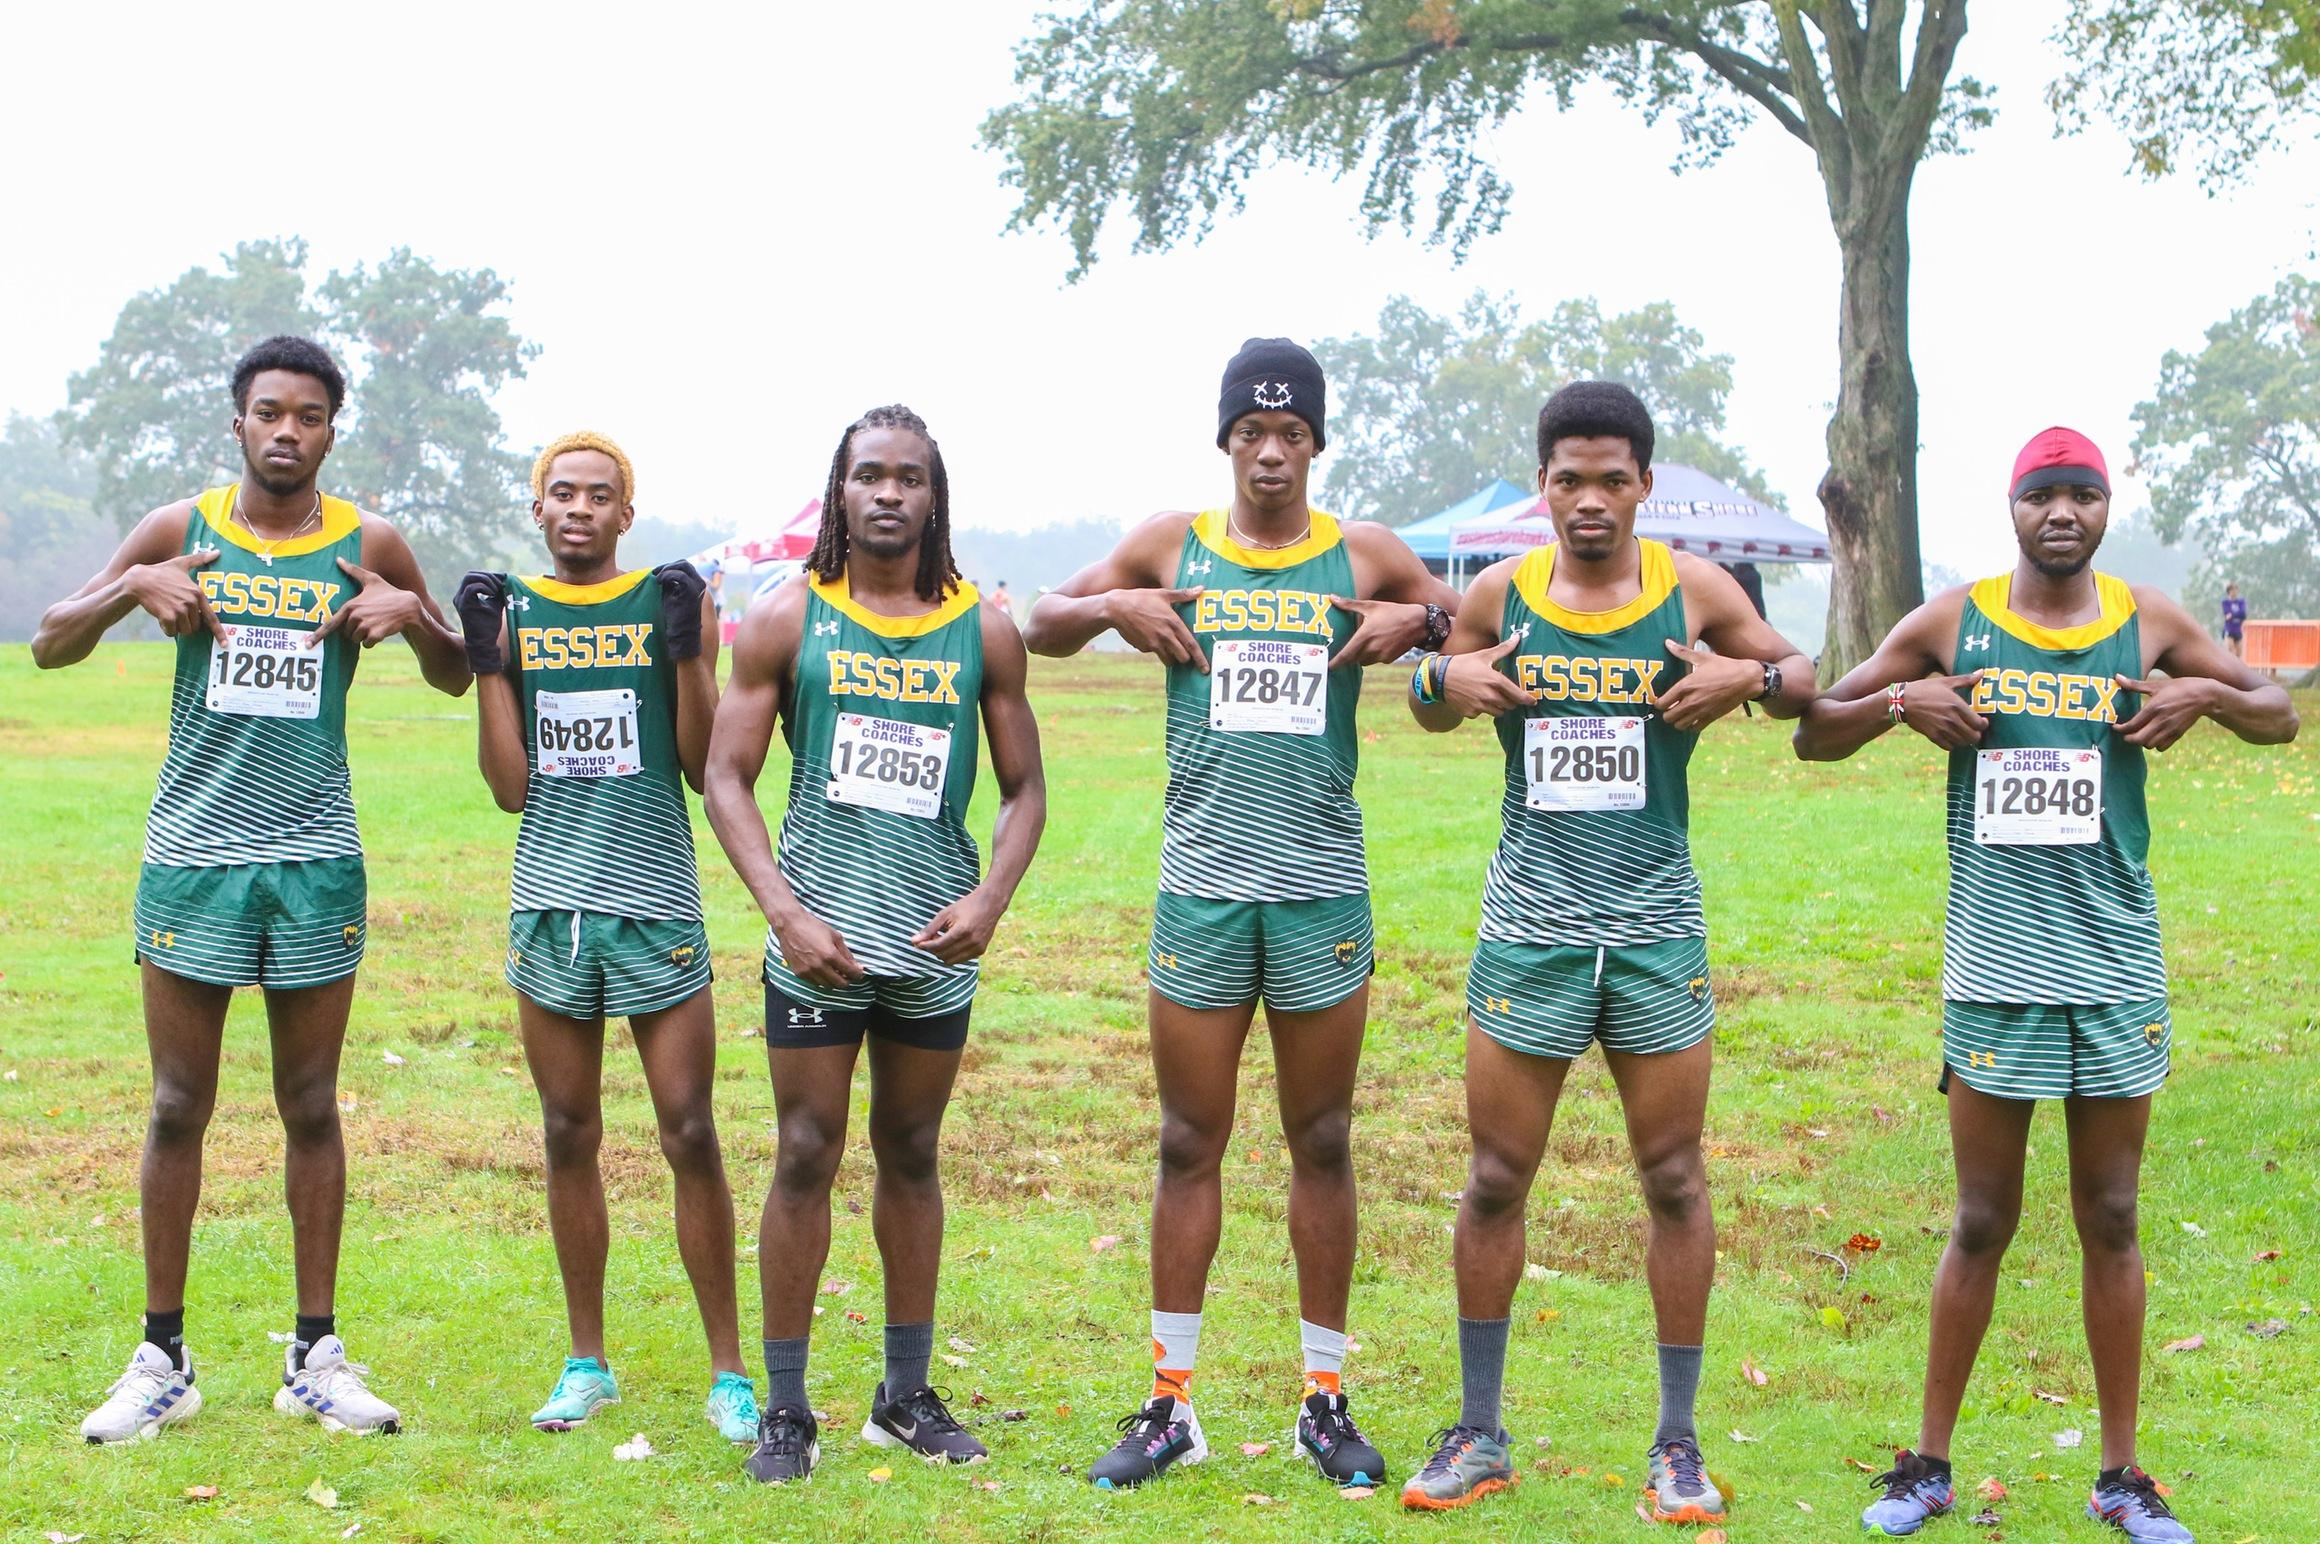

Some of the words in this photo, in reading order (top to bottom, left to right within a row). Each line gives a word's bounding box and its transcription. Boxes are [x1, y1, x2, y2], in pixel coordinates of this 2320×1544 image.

[196, 571, 341, 624] ESSEX
[1193, 589, 1334, 638] ESSEX
[237, 637, 297, 651] COACHES
[246, 627, 289, 640] SHORE
[517, 623, 653, 671] ESSEX
[1238, 652, 1301, 665] COACHES
[1248, 642, 1292, 654] SHORE
[216, 651, 318, 692] 12845
[827, 650, 961, 704] ESSEX
[1516, 655, 1664, 704] ESSEX
[1217, 668, 1322, 707] 12847
[1970, 667, 2122, 724] ESSEX
[539, 716, 634, 752] 12849
[872, 719, 916, 736] SHORE
[1550, 729, 1616, 740] COACHES
[1560, 718, 1606, 729] SHORE
[861, 728, 924, 747] COACHES
[557, 755, 615, 765] COACHES
[838, 740, 942, 791] 12853
[1529, 745, 1639, 783] 12850
[2003, 761, 2071, 772] COACHES
[2013, 750, 2060, 760] SHORE
[566, 766, 607, 776] SHORE
[1982, 777, 2095, 817] 12848
